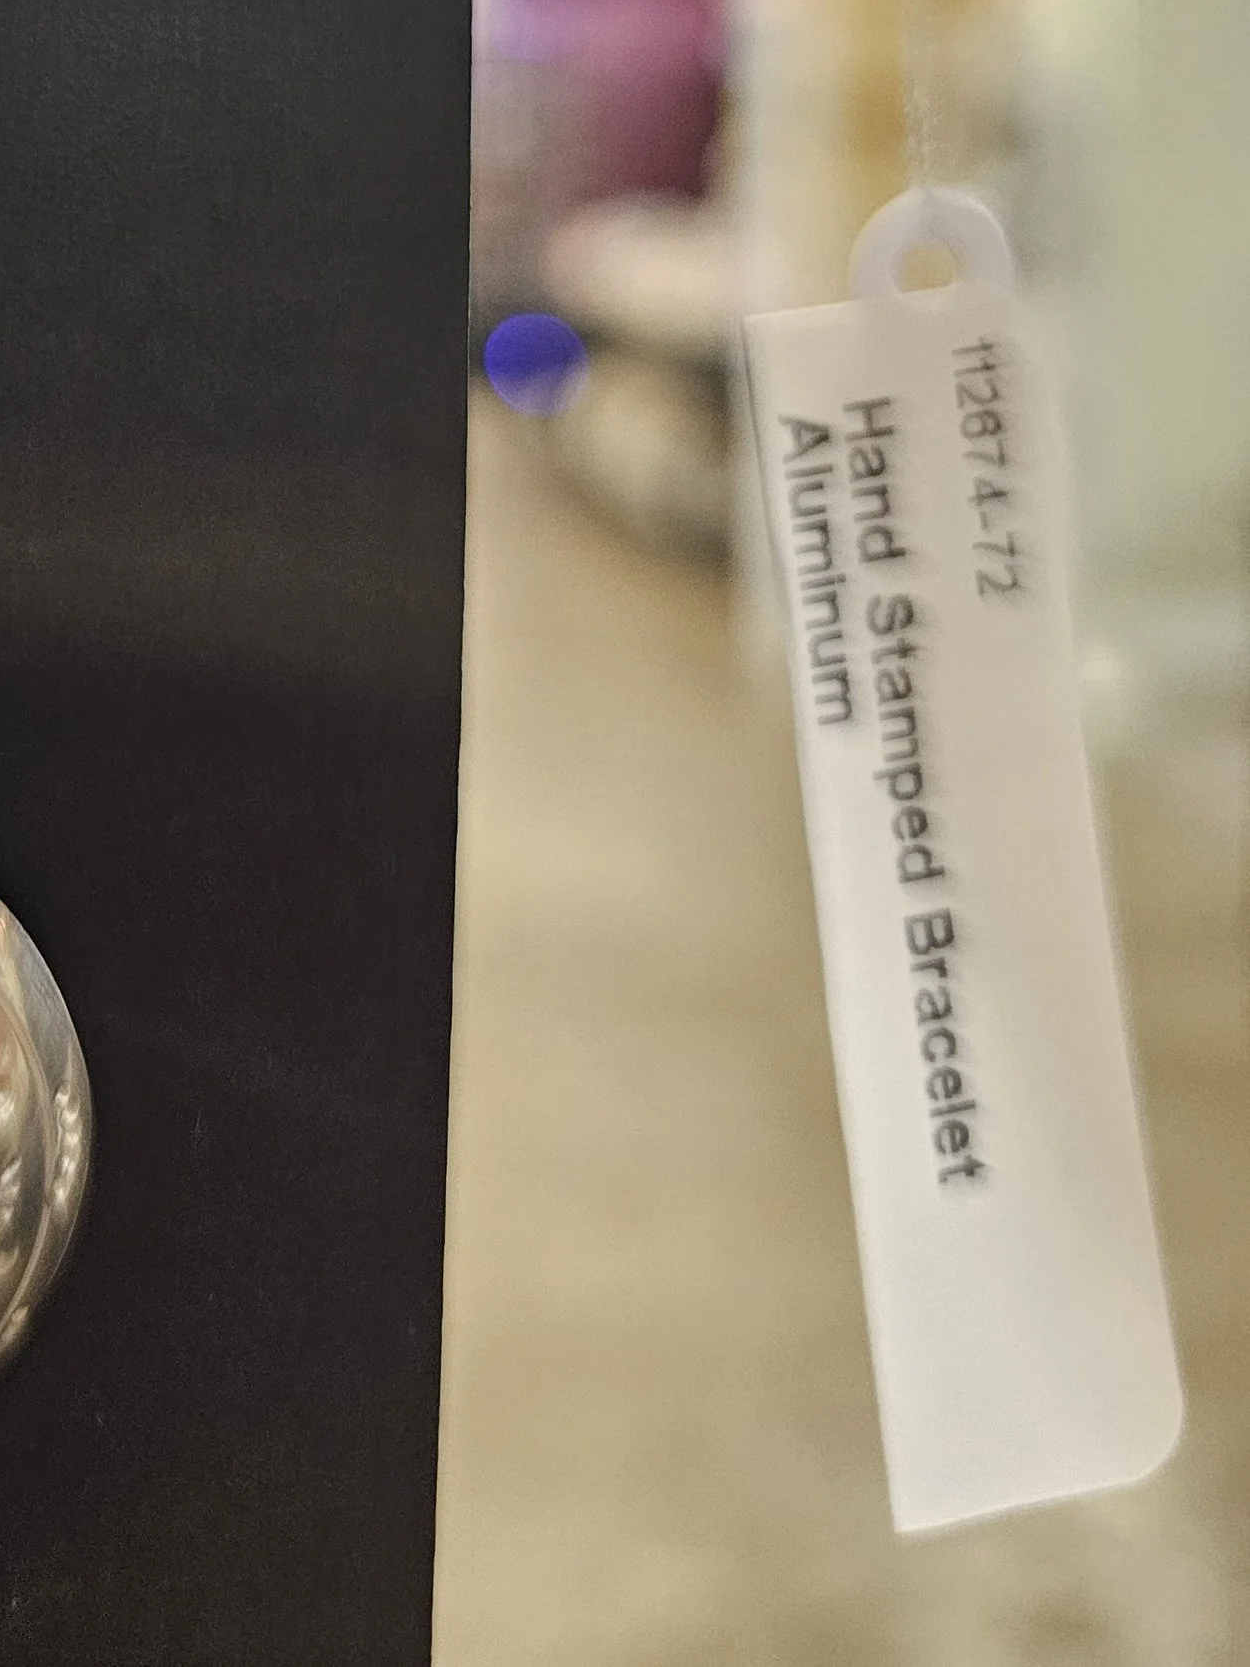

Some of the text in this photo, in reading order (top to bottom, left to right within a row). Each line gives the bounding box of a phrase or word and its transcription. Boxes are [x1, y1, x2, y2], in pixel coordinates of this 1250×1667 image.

[778, 414, 853, 726] Aluminum
[842, 395, 988, 1184] Hand Stamped Bracelet
